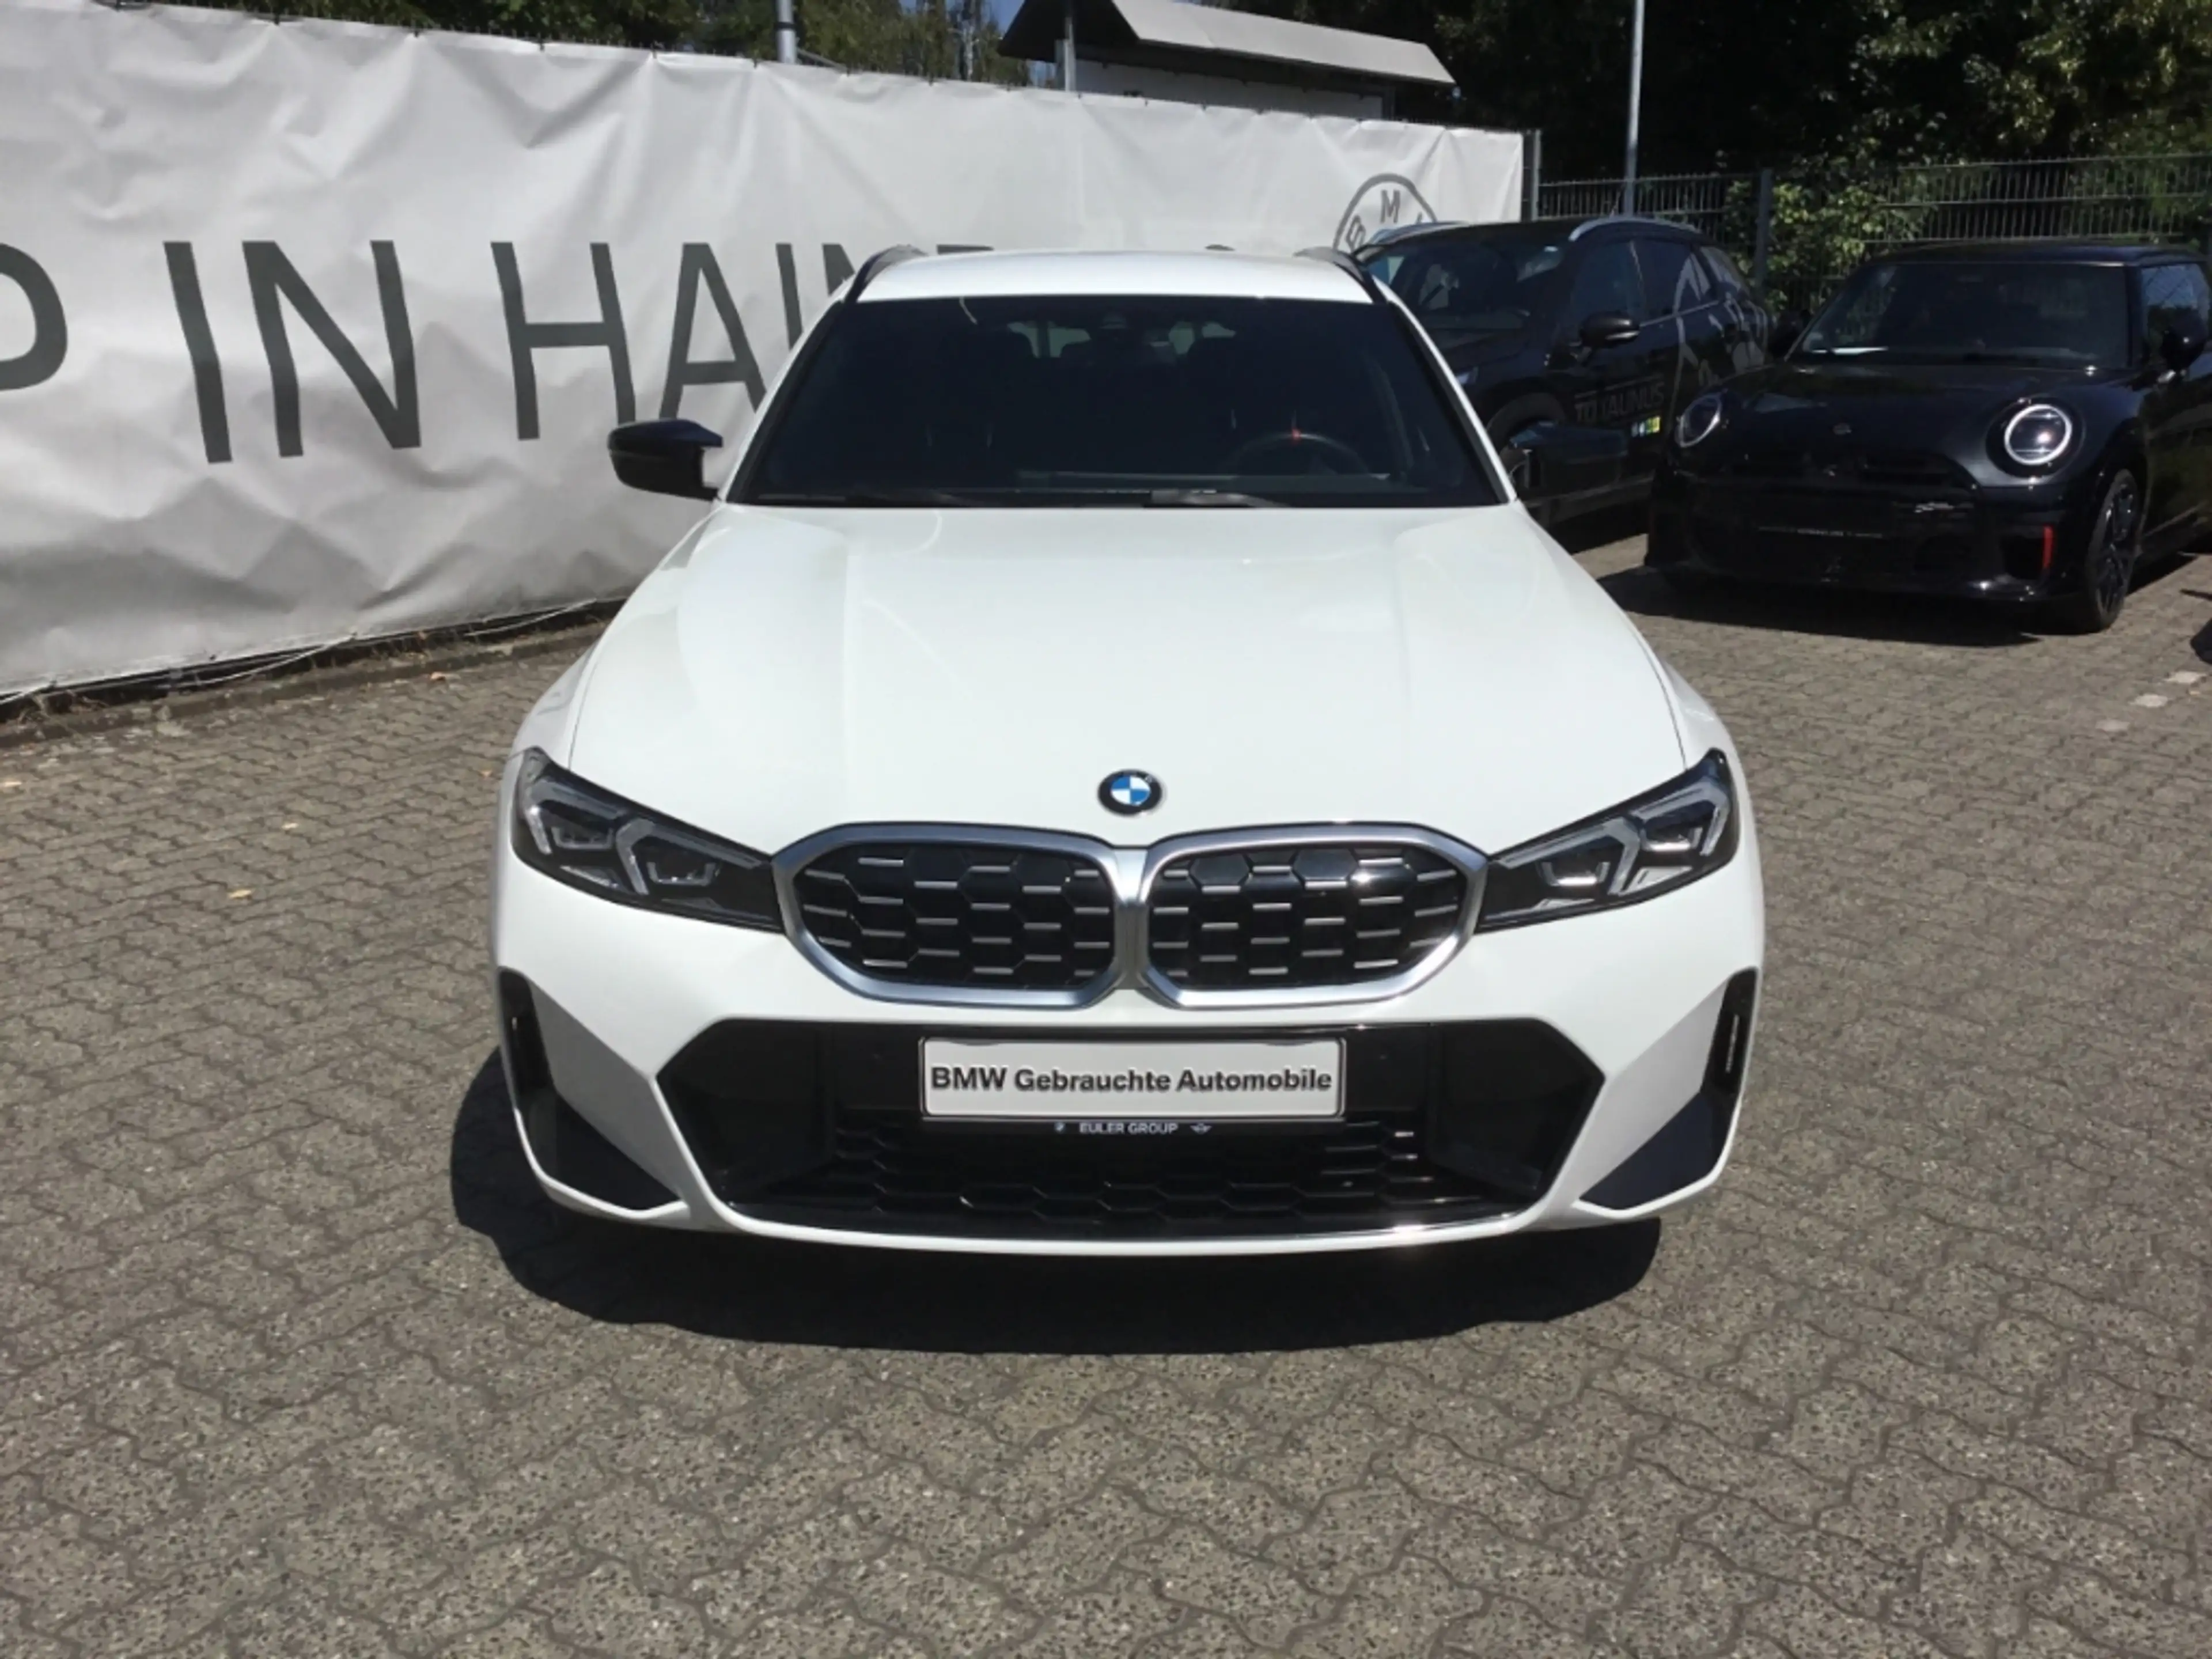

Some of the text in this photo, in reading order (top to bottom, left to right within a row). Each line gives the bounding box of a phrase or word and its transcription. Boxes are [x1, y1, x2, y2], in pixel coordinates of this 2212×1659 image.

[163, 240, 421, 464] IN
[930, 1066, 1332, 1093] BMW Gebrauchte Automobile
[1079, 1122, 1178, 1134] EULER GROUP
